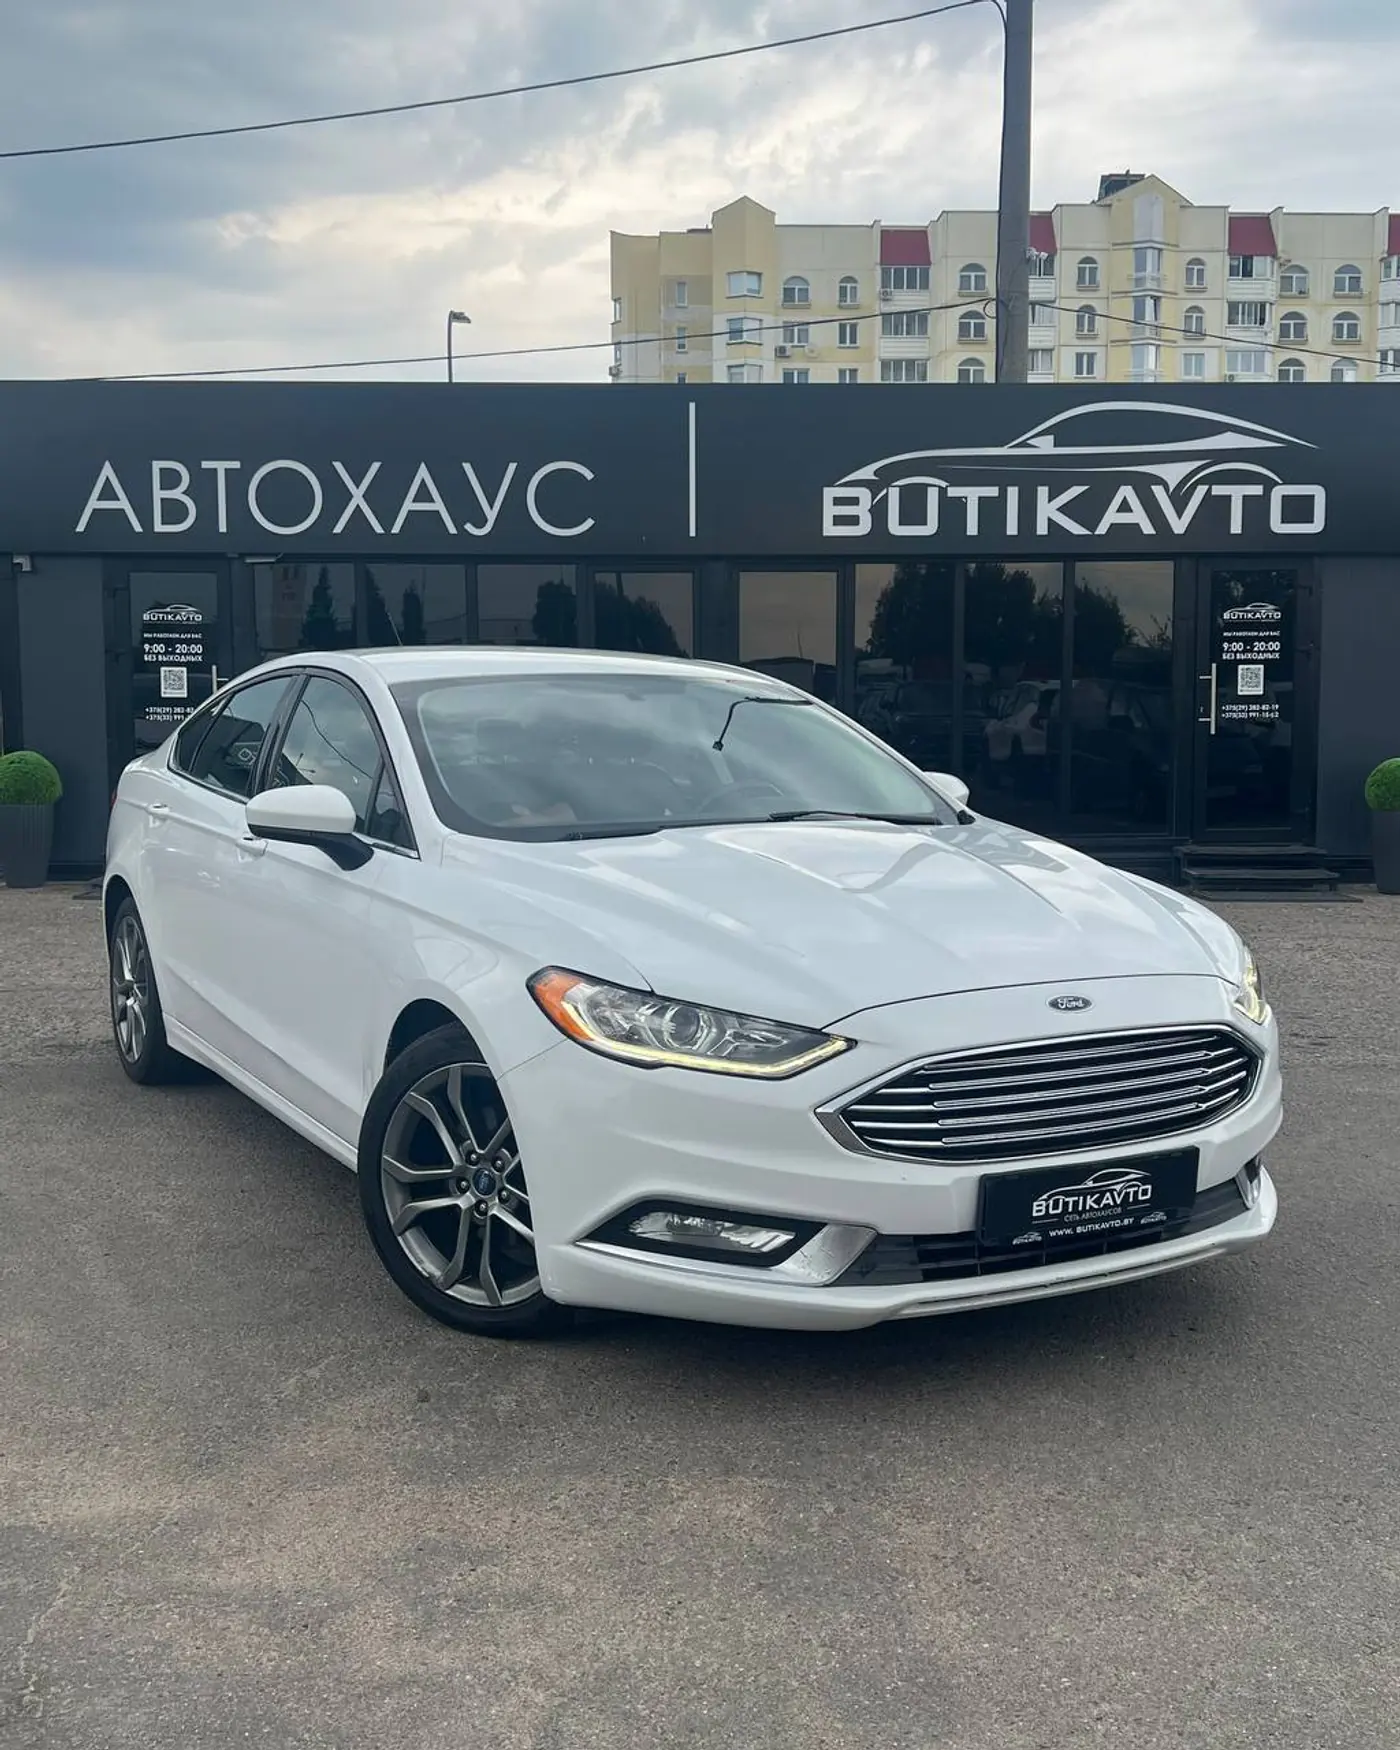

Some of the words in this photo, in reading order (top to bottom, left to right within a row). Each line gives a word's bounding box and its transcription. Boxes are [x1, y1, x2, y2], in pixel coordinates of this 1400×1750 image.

[75, 459, 596, 536] АВТОХАУС
[822, 483, 1326, 537] BUTIKAVTO
[143, 613, 203, 621] BUTIKAVTO
[1223, 611, 1282, 619] BUTIKAVTO
[143, 643, 165, 653] 9:00
[175, 643, 203, 653] 20:00
[1223, 642, 1244, 651] 9:00
[1253, 641, 1280, 651] 20:00
[158, 654, 203, 662] ВЫХОДНЫХ
[1236, 652, 1280, 660] ВЫХОДНЫХ
[1057, 997, 1085, 1009] Ford
[1032, 1185, 1152, 1217] BUTIKAVTO
[1048, 1228, 1074, 1237] WWW.
[1076, 1217, 1135, 1234] BUTIKAVTO.BY
